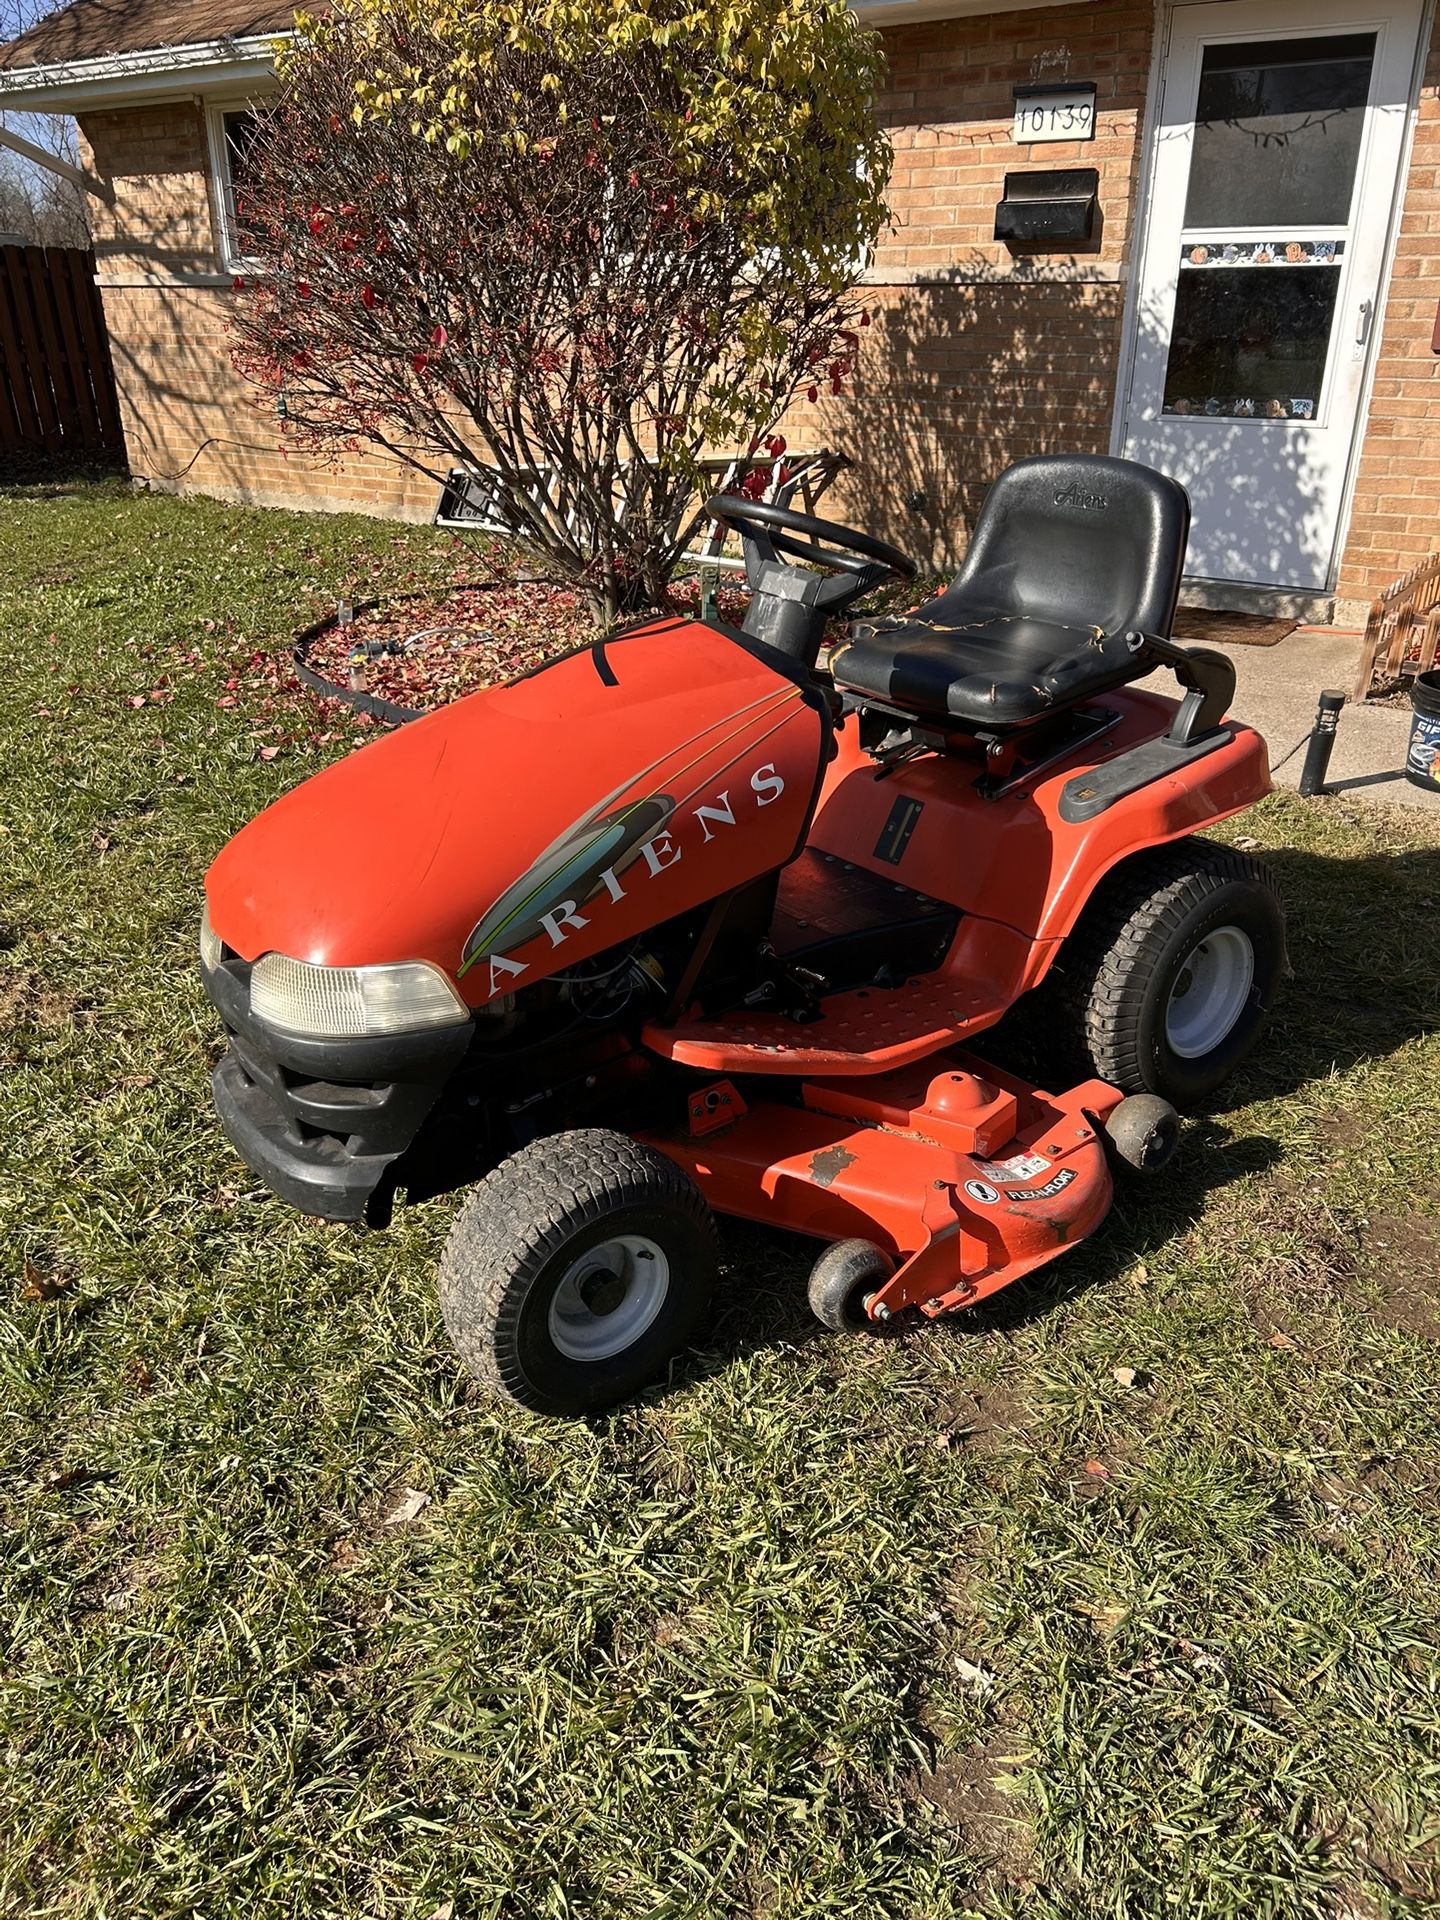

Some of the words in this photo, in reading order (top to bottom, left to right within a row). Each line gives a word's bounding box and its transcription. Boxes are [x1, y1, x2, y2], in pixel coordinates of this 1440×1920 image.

[1020, 104, 1091, 132] 10139
[1053, 481, 1107, 511] Ariens
[488, 763, 785, 998] ARIENS
